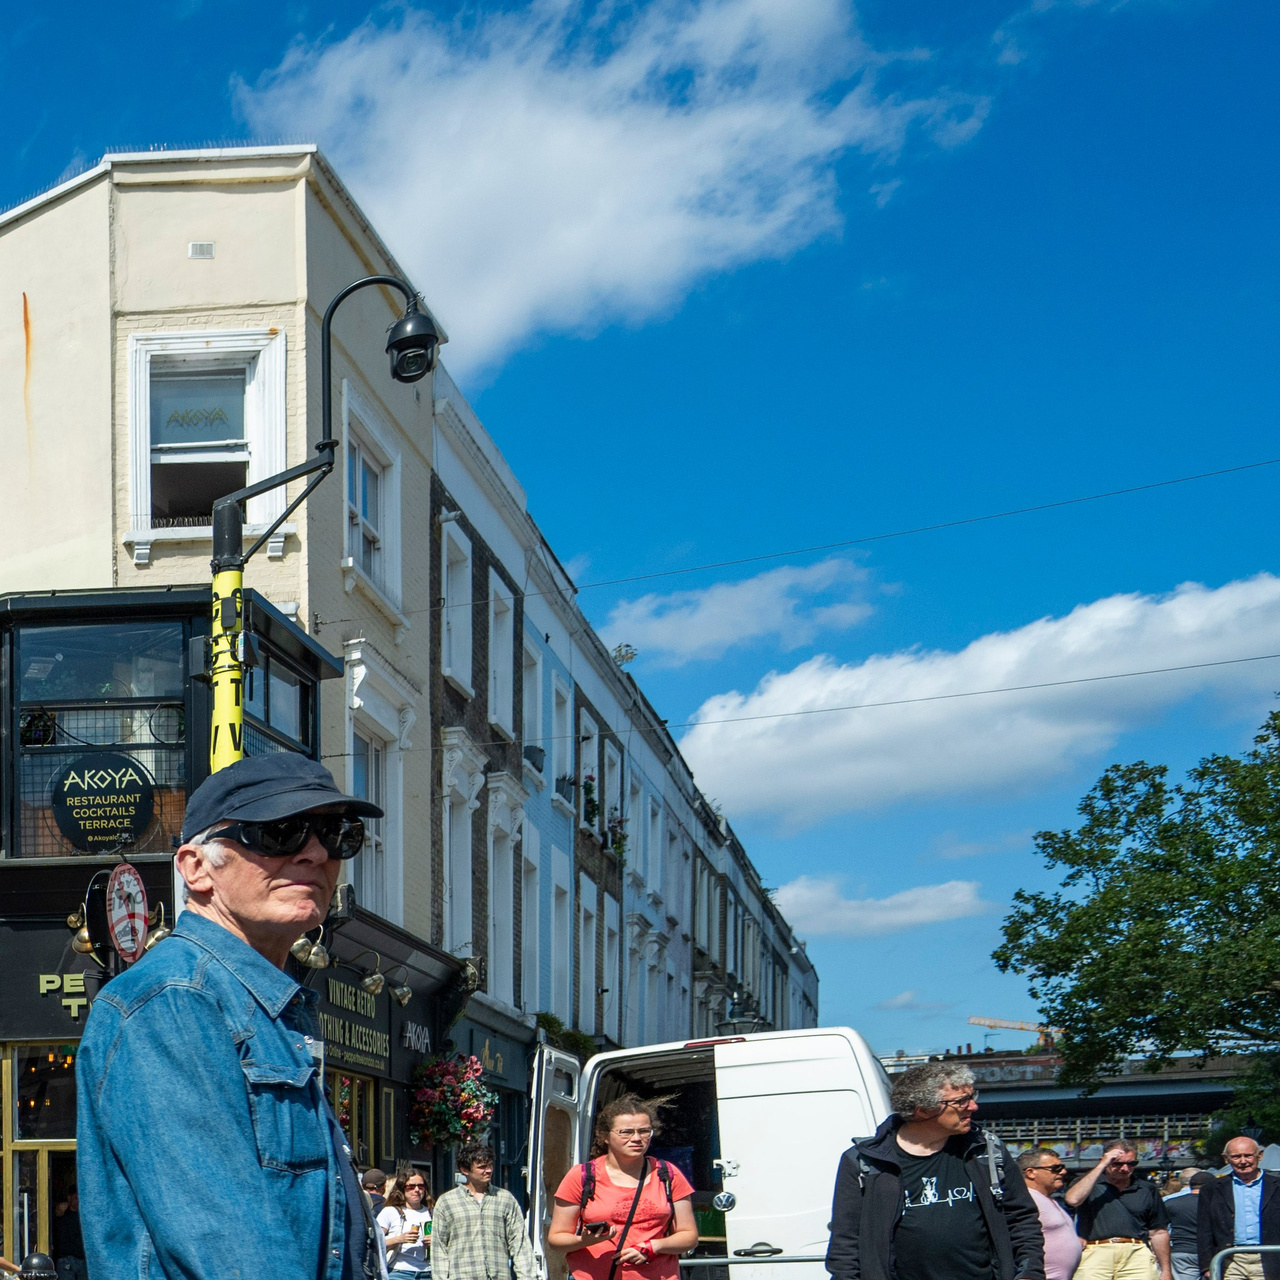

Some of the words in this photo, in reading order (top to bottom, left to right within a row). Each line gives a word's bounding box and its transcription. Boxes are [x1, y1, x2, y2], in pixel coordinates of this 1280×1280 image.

[168, 407, 229, 425] AKOYA
[63, 767, 143, 792] AKOYA
[66, 793, 141, 806] RESTAURANT
[72, 806, 135, 818] COCKTAILS
[78, 818, 131, 830] TERRACE
[328, 977, 356, 1012] VINTAGE
[356, 991, 376, 1020] RETRO
[319, 1011, 344, 1046] OTHING
[344, 1021, 350, 1047] &
[350, 1023, 390, 1058] ACCESSORIES
[403, 1020, 431, 1054] AKOYA
